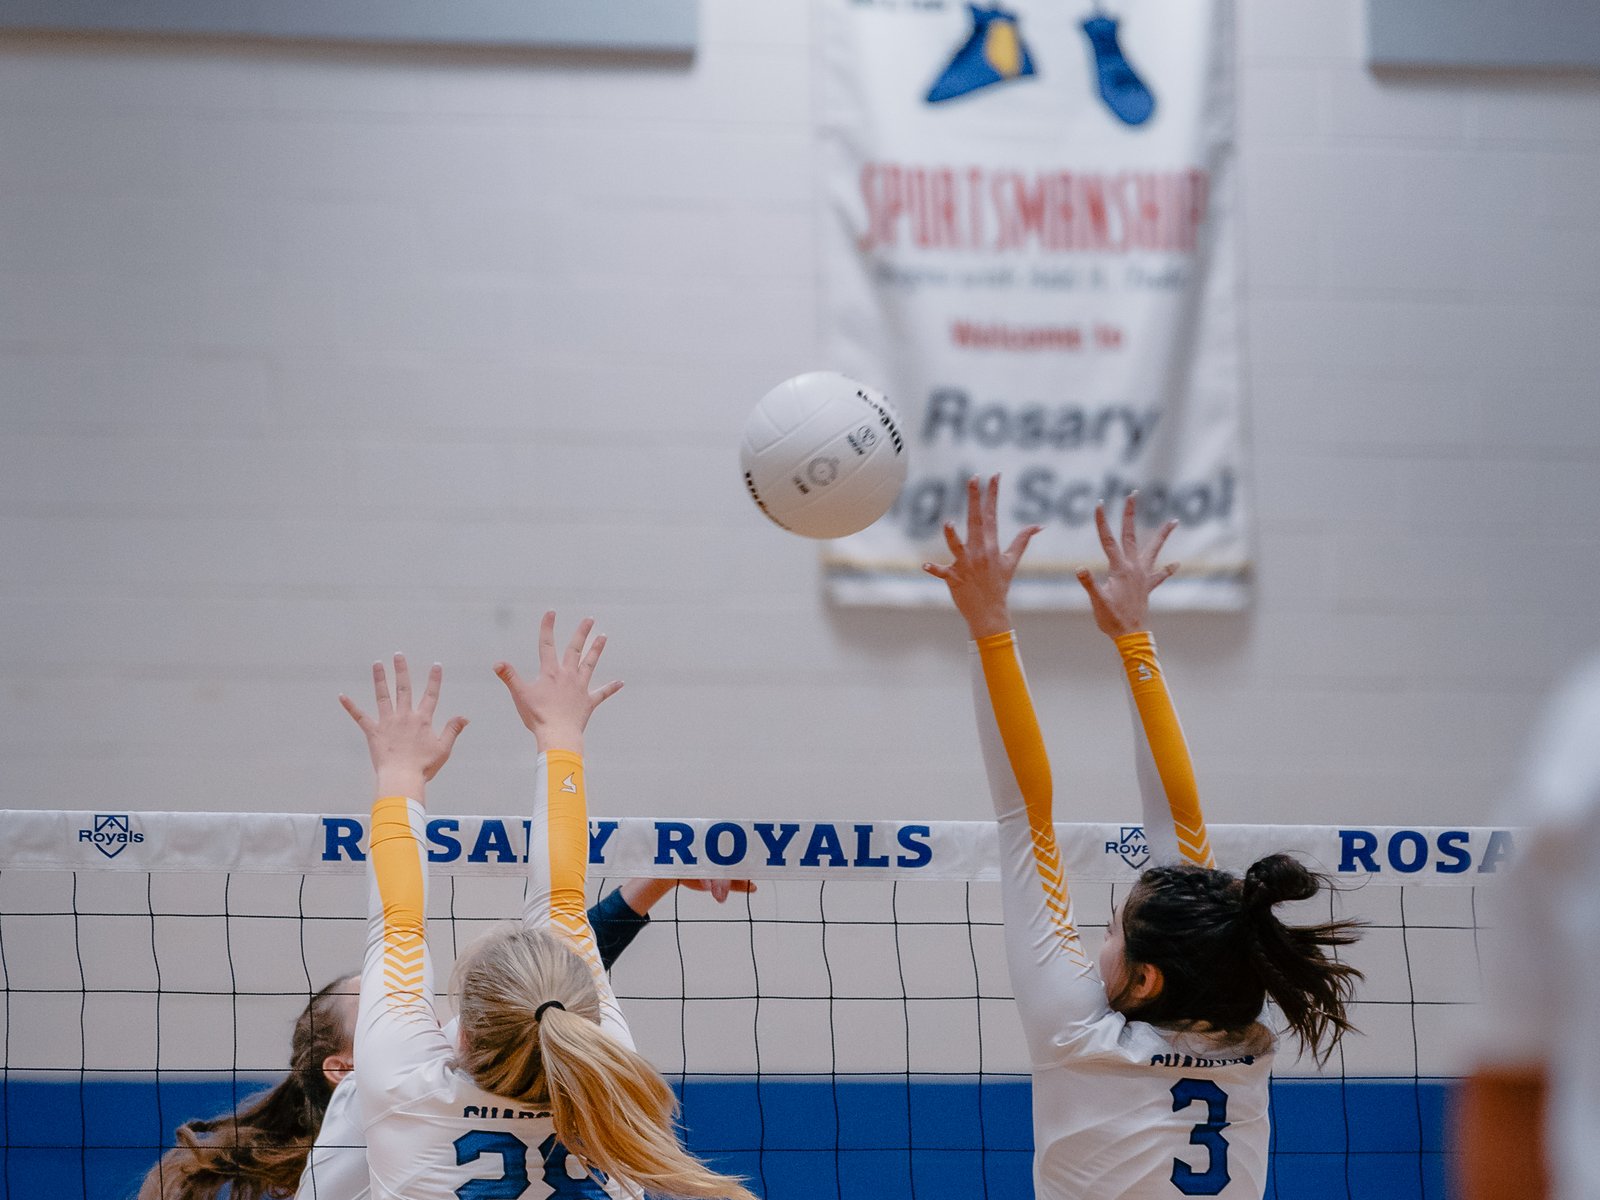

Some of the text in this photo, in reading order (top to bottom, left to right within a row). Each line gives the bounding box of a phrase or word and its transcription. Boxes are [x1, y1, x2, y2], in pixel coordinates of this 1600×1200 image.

[920, 383, 1162, 464] Rosary
[1010, 465, 1237, 528] School
[79, 829, 144, 845] Royals
[321, 817, 933, 868] RSAY ROYALS
[1105, 841, 1150, 857] Roya
[1337, 830, 1515, 873] ROSA
[1169, 1077, 1232, 1196] 3
